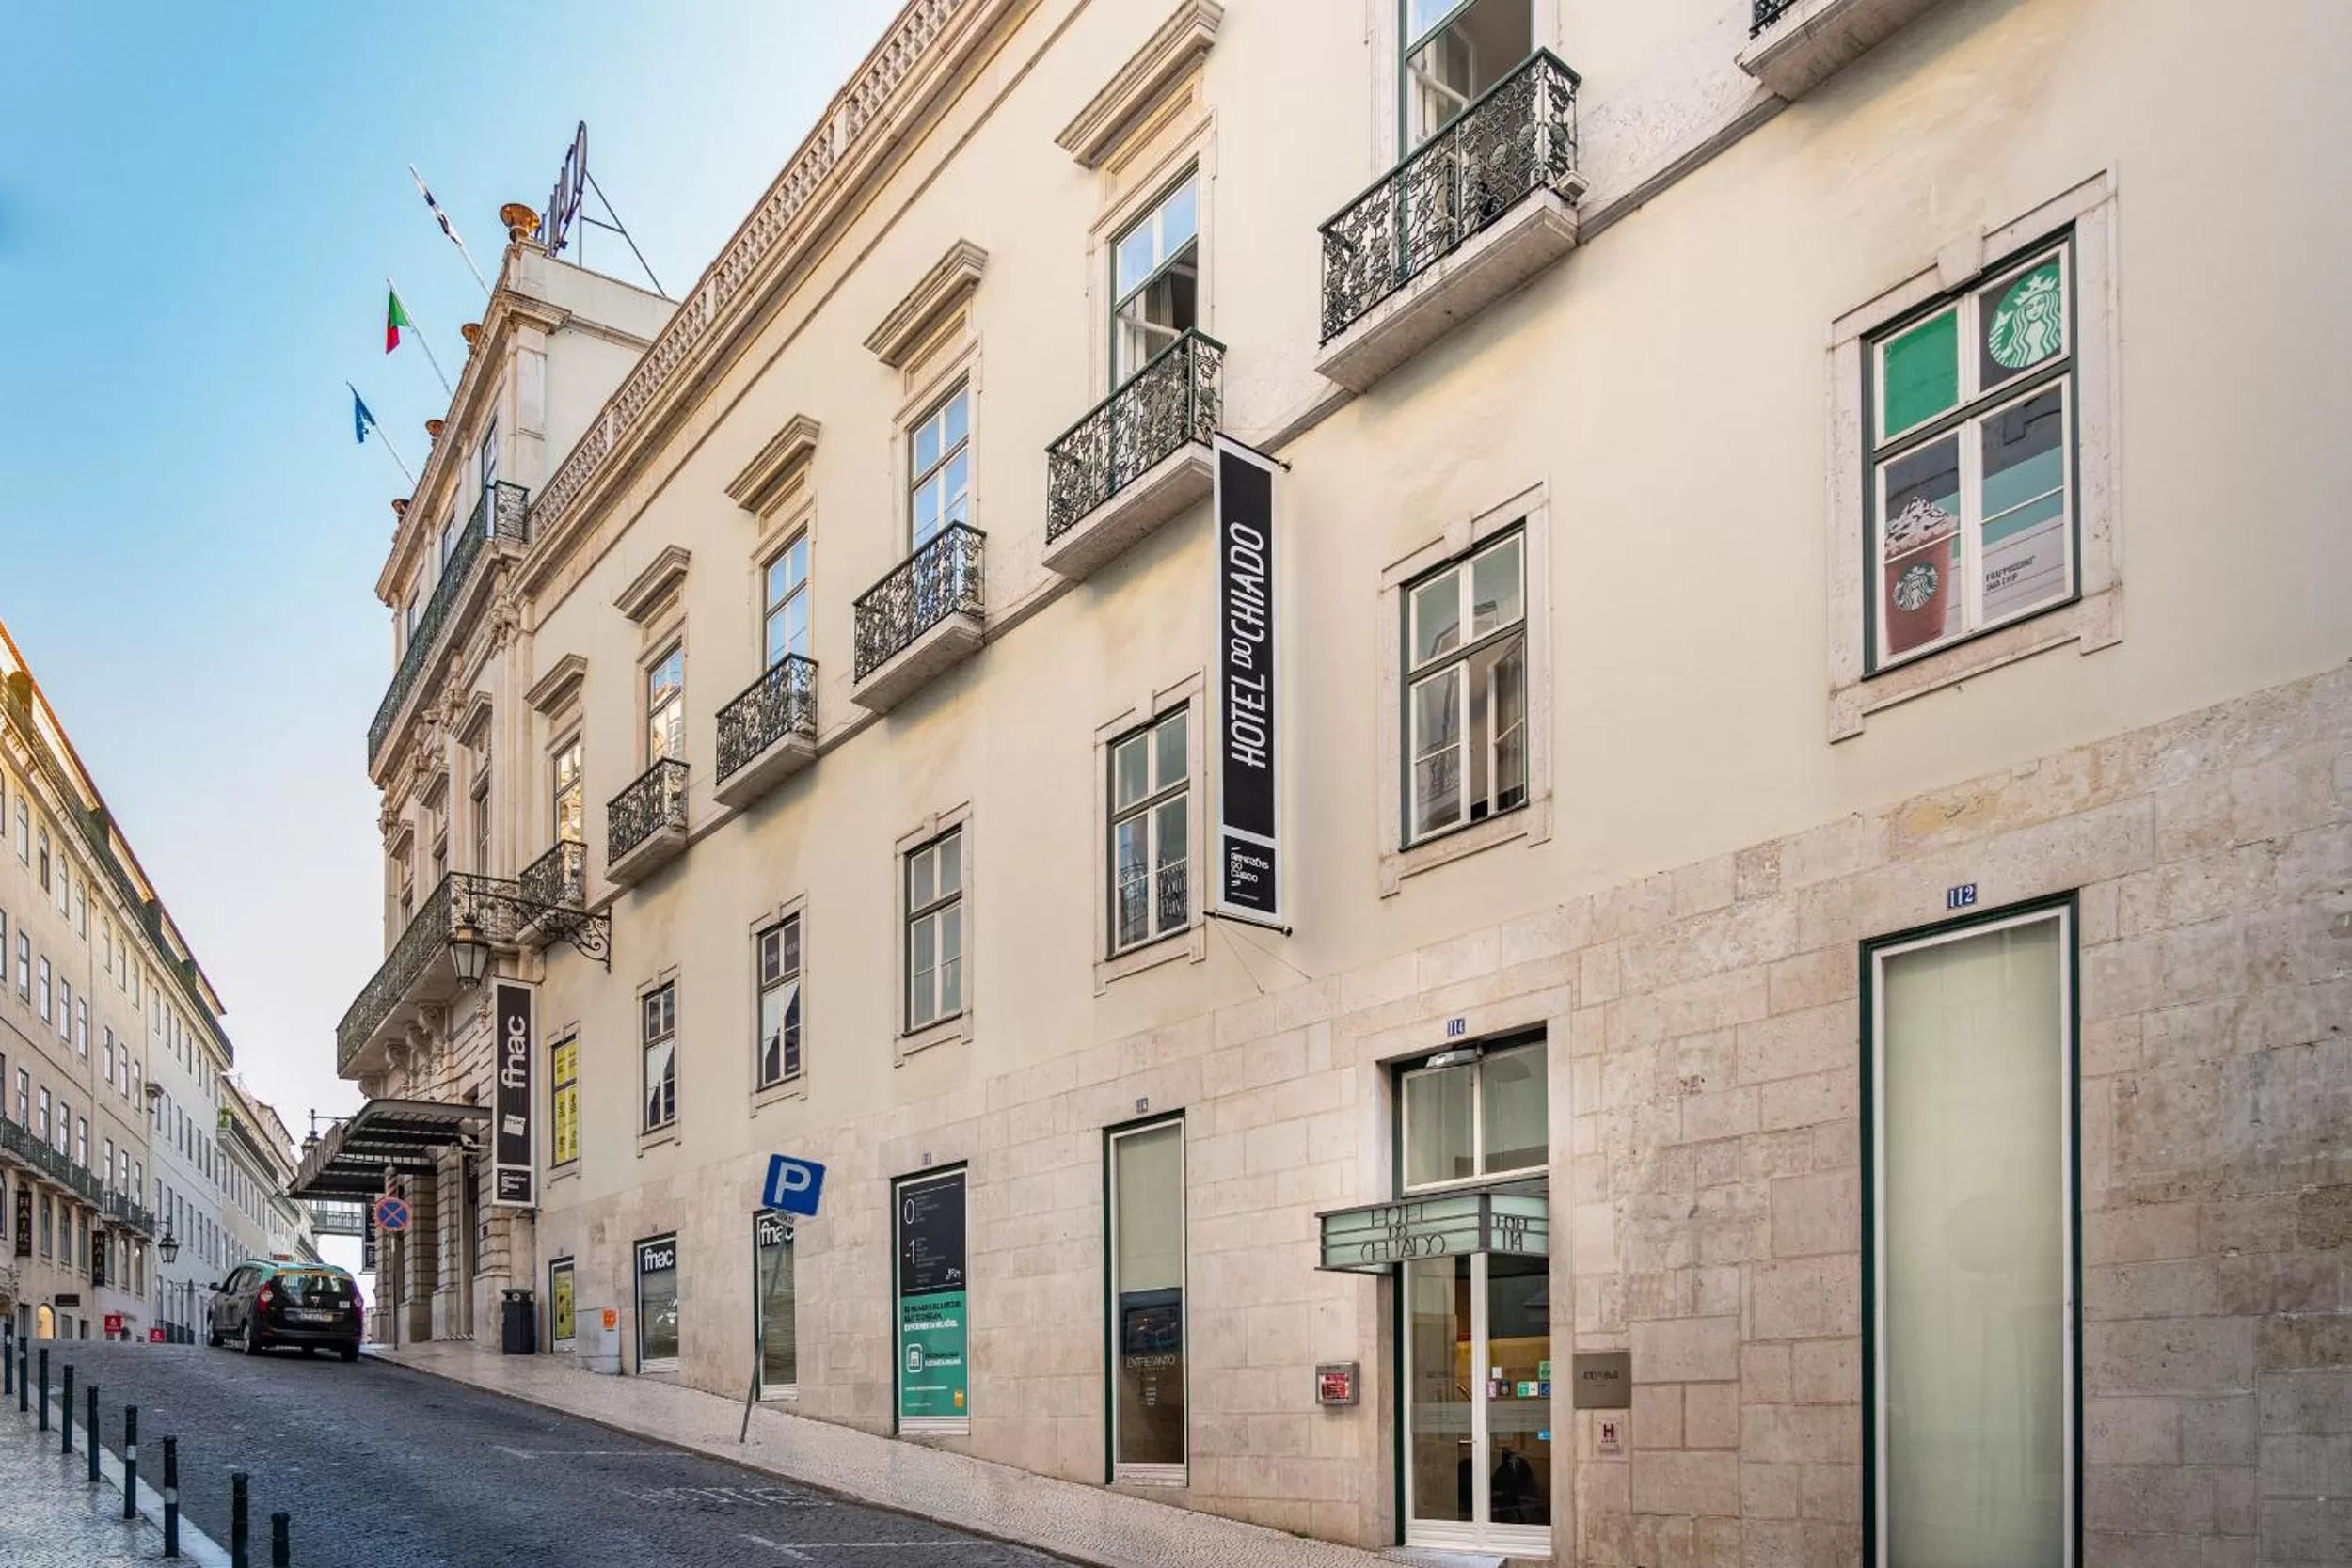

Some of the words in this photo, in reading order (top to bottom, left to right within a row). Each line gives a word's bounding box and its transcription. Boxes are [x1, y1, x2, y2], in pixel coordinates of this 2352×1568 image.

[1229, 521, 1265, 643] CHIADO
[1231, 637, 1252, 670] DO
[1231, 673, 1266, 769] HOTEL
[1949, 885, 1974, 907] 112
[501, 1015, 527, 1089] fnac
[774, 1161, 812, 1205] P
[1371, 1203, 1424, 1228] HOTEL
[644, 1248, 674, 1271] fnac
[1360, 1234, 1446, 1261] CHIADO
[1603, 1423, 1614, 1438] H
